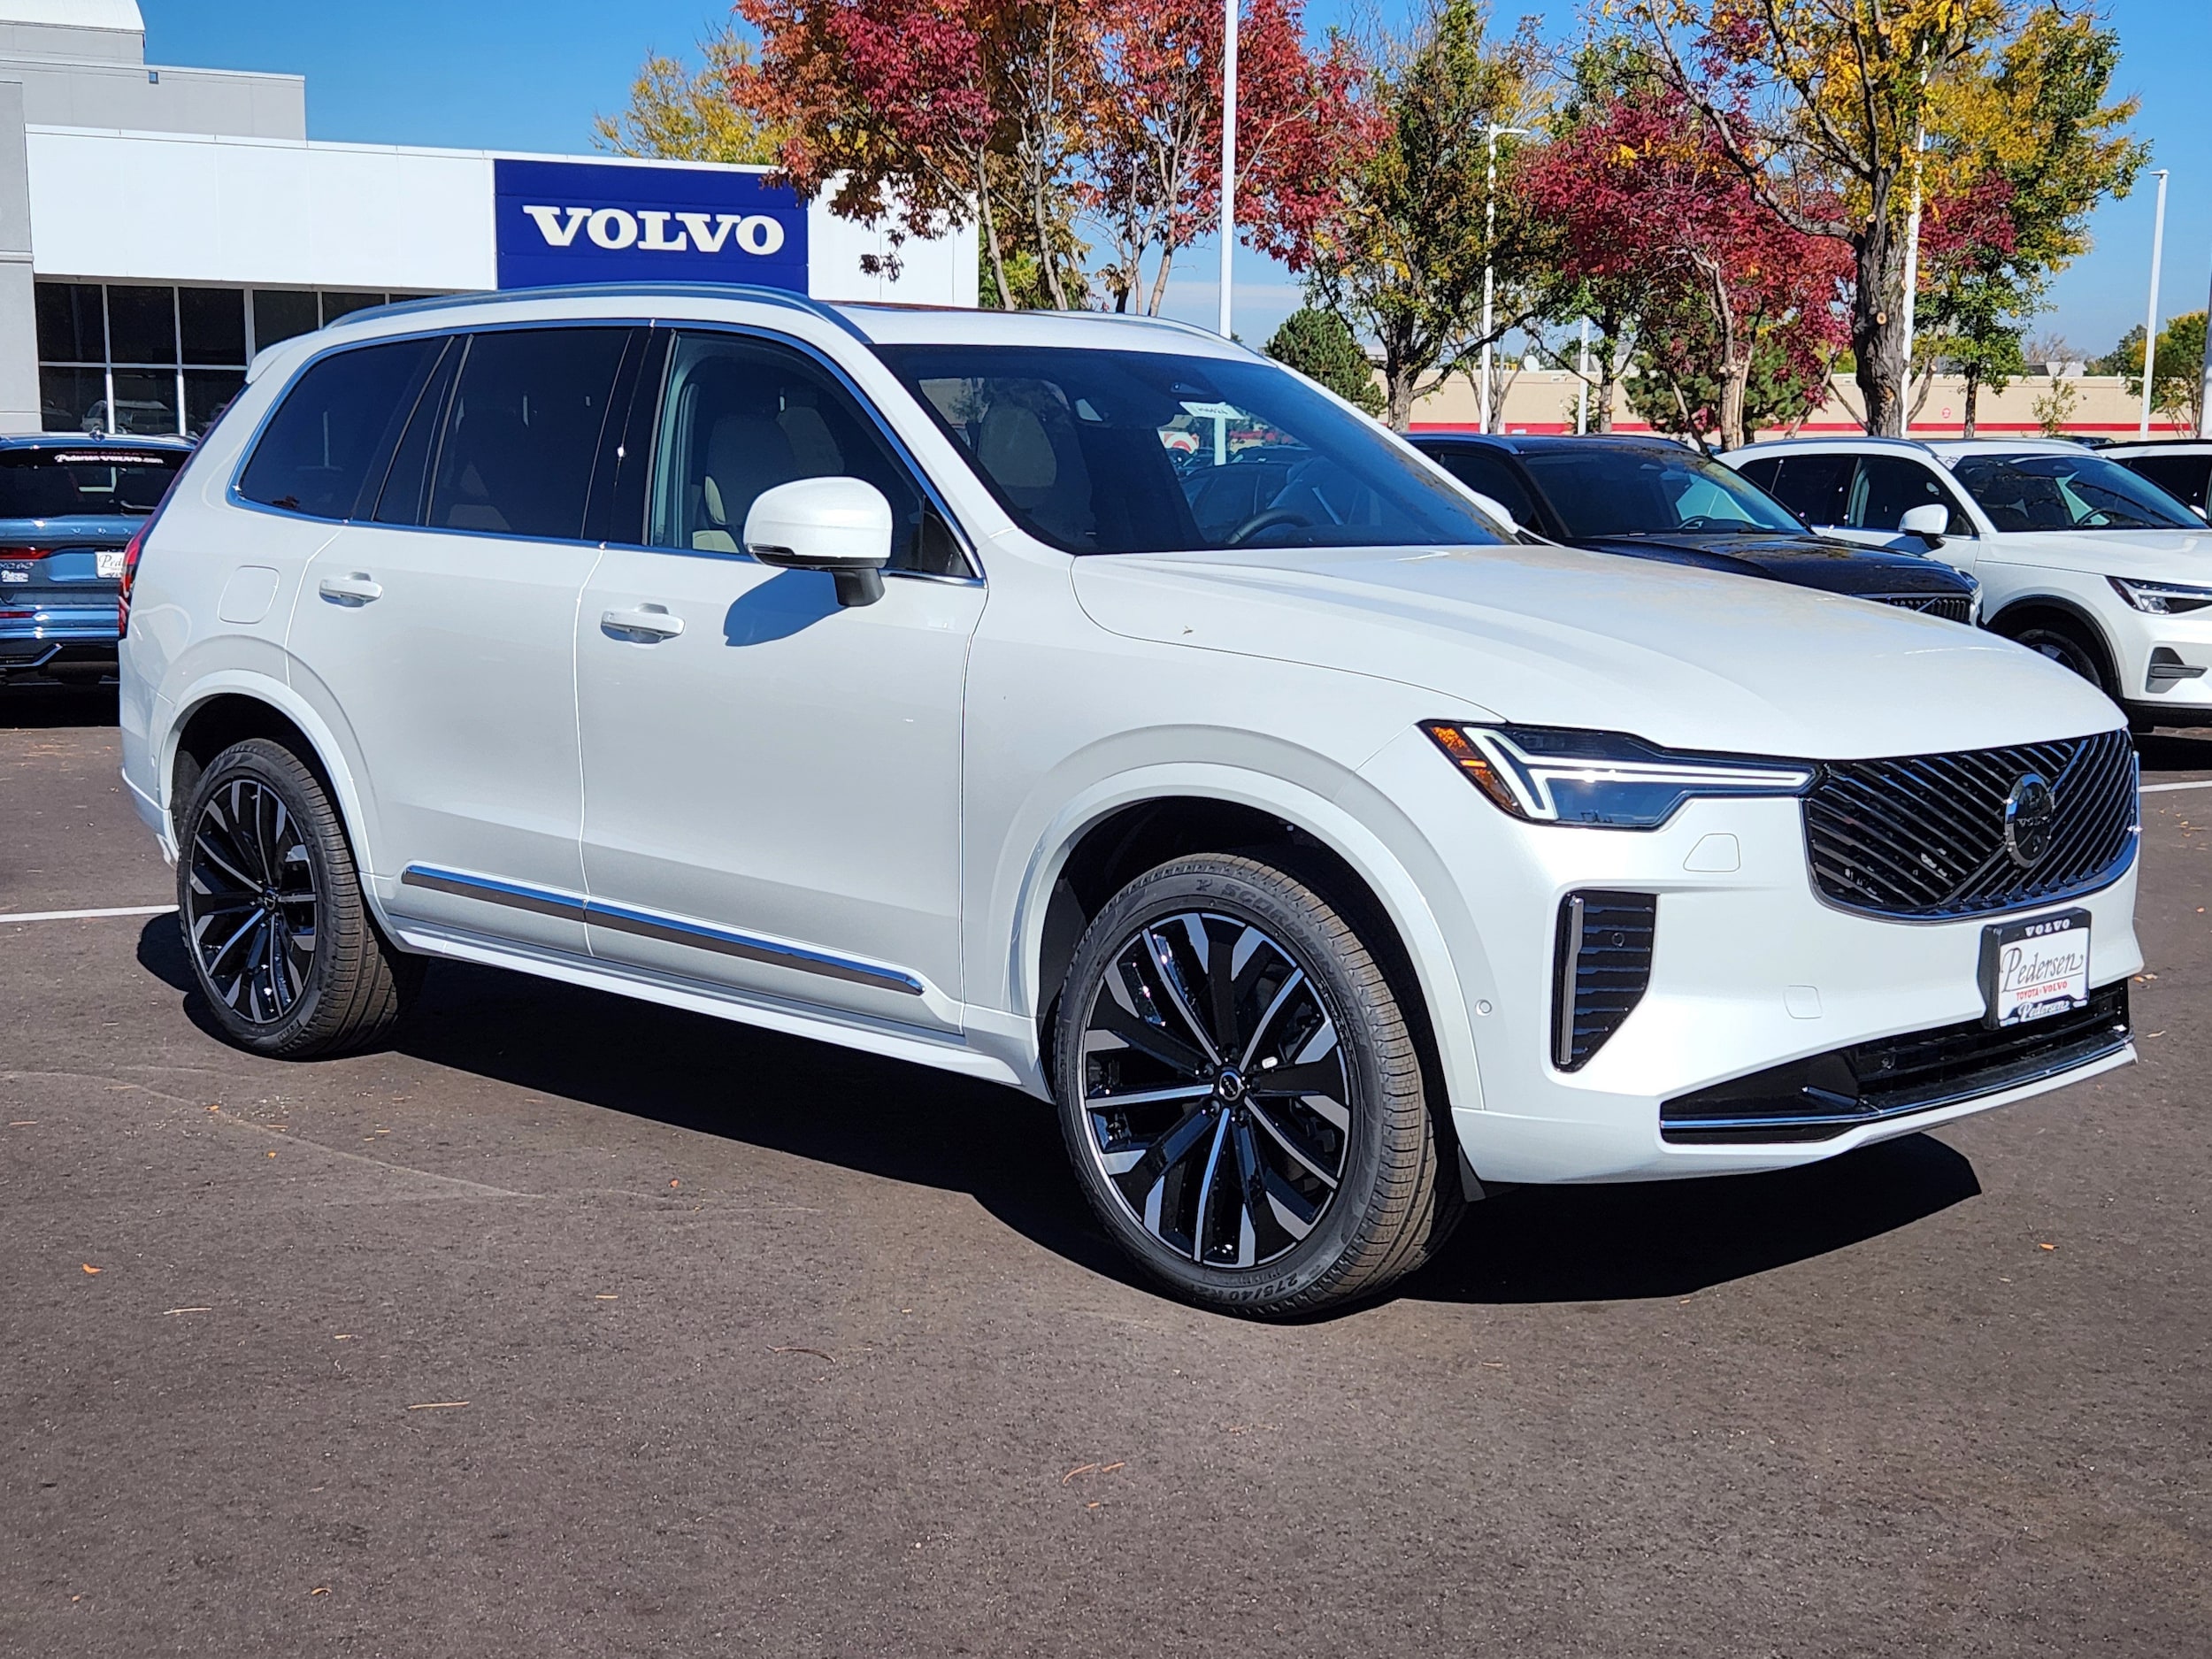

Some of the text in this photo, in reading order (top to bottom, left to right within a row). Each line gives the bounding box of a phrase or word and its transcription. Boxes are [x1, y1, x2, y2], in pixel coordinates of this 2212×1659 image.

[522, 204, 785, 256] VOLVO
[2024, 918, 2071, 937] VOLVO
[2001, 947, 2085, 993] Pedersen
[2016, 980, 2068, 1001] TOYOTA VOLVO
[2017, 1001, 2070, 1022] Pedersen
